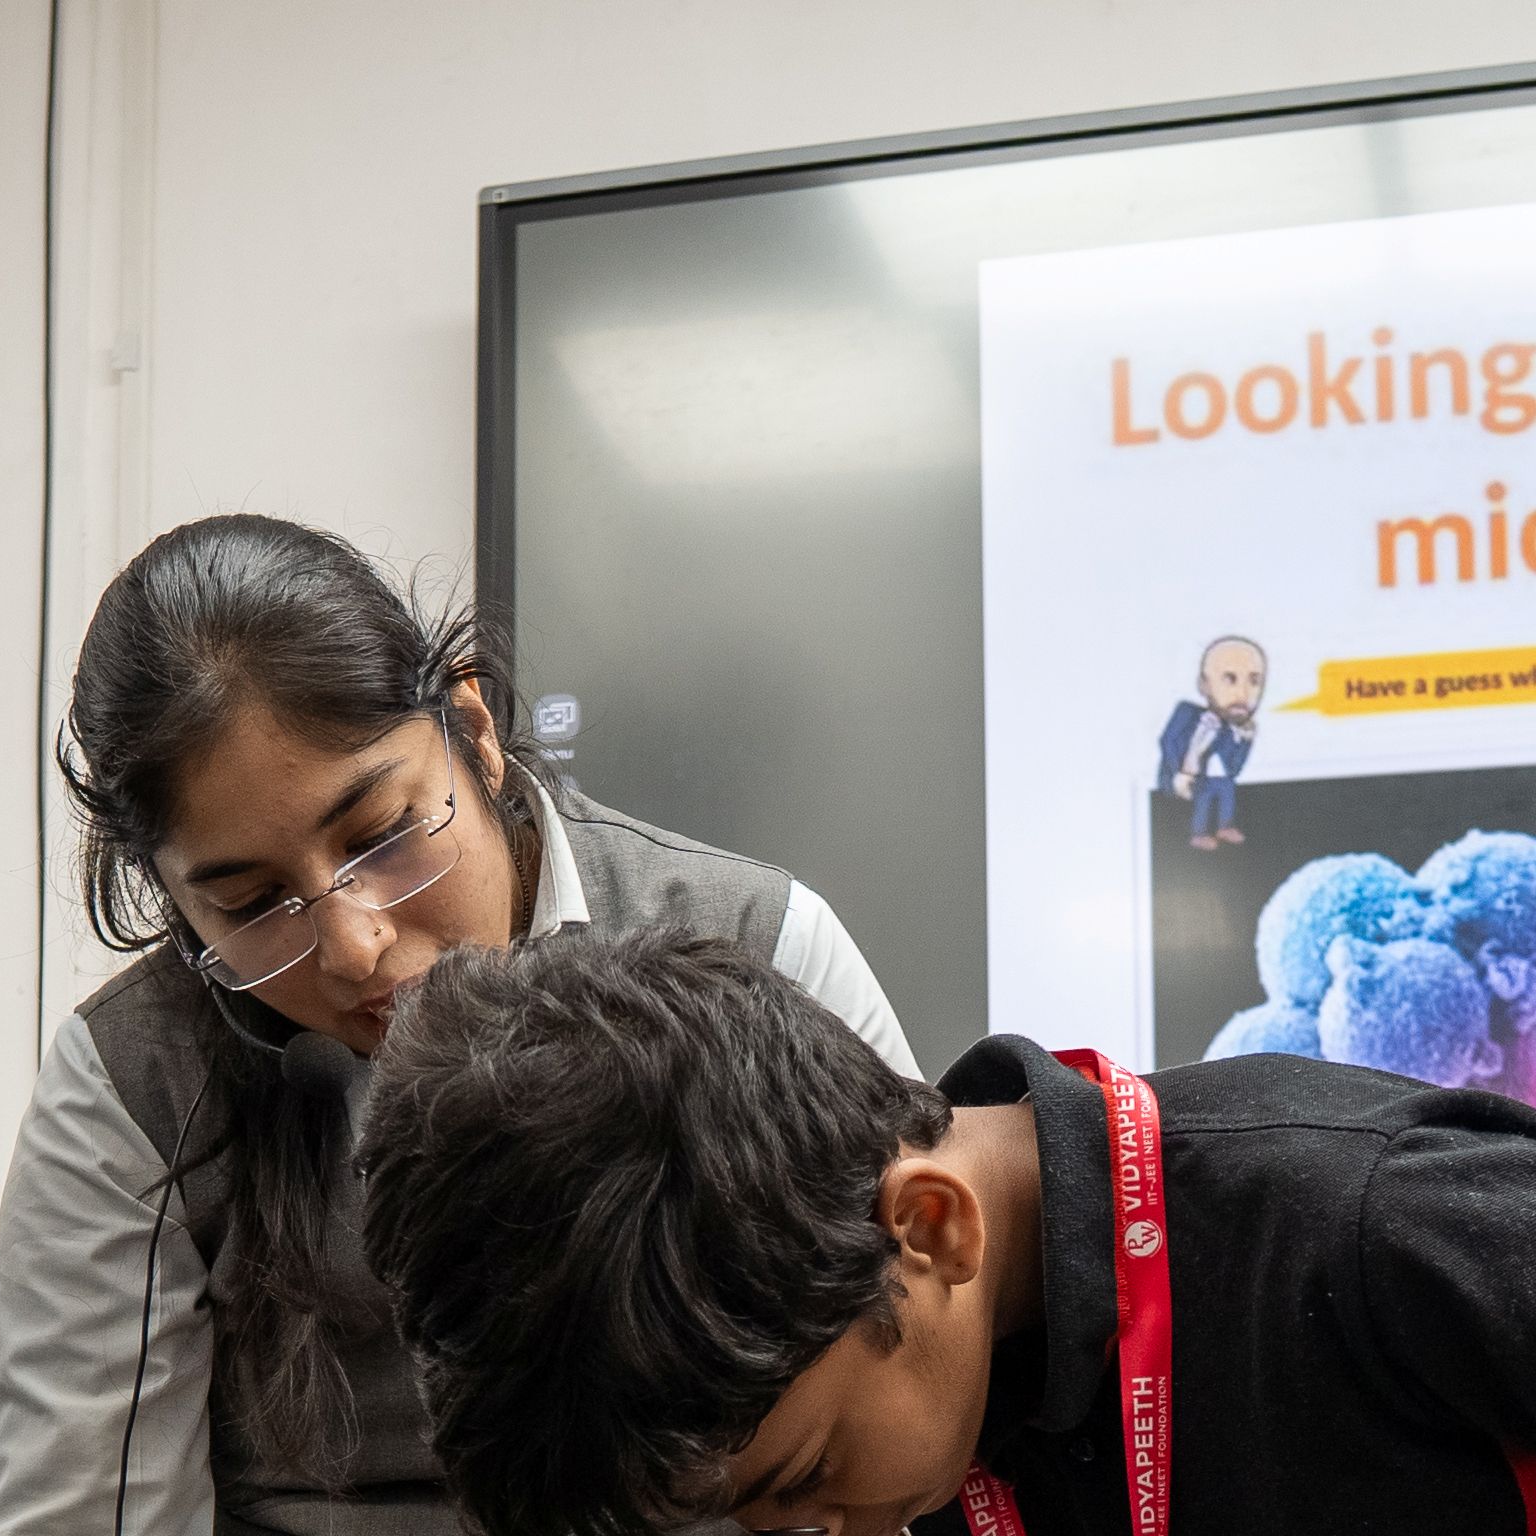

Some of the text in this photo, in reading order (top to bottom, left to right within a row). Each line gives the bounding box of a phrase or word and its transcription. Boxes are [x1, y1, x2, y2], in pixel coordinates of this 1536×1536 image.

[1345, 677, 1406, 698] Have
[1414, 679, 1427, 694] a
[1434, 674, 1503, 698] guess
[1110, 1064, 1141, 1213] VIDYAPEET
[1142, 1126, 1155, 1154] NEET
[1144, 1163, 1158, 1206] IIT-JEE
[1157, 1375, 1168, 1458] FOUNDATION
[1157, 1466, 1167, 1497] NEET
